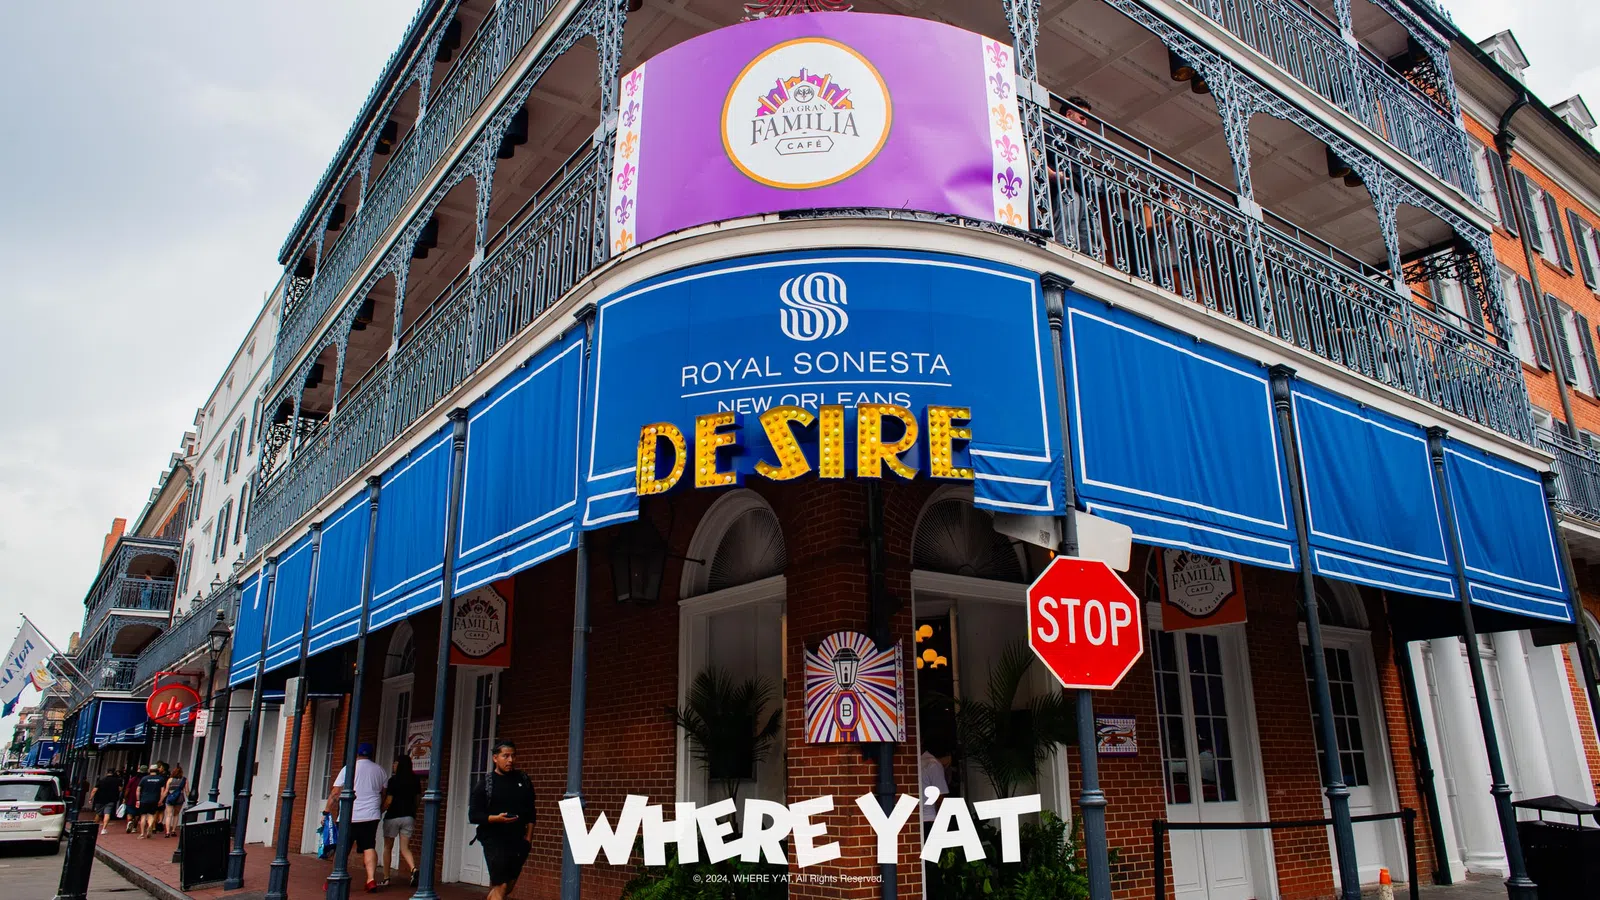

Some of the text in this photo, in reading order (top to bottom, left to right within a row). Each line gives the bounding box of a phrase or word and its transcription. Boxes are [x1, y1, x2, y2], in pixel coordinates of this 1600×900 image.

[751, 112, 860, 145] FAMILIA
[787, 139, 822, 150] CAFÉ
[680, 351, 952, 387] ROYAL SONESTA
[717, 395, 773, 415] NEW
[636, 402, 977, 497] DESIRE
[1171, 566, 1227, 590] FAMILIA
[454, 618, 500, 634] FAMILIA
[1036, 595, 1132, 647] STOP
